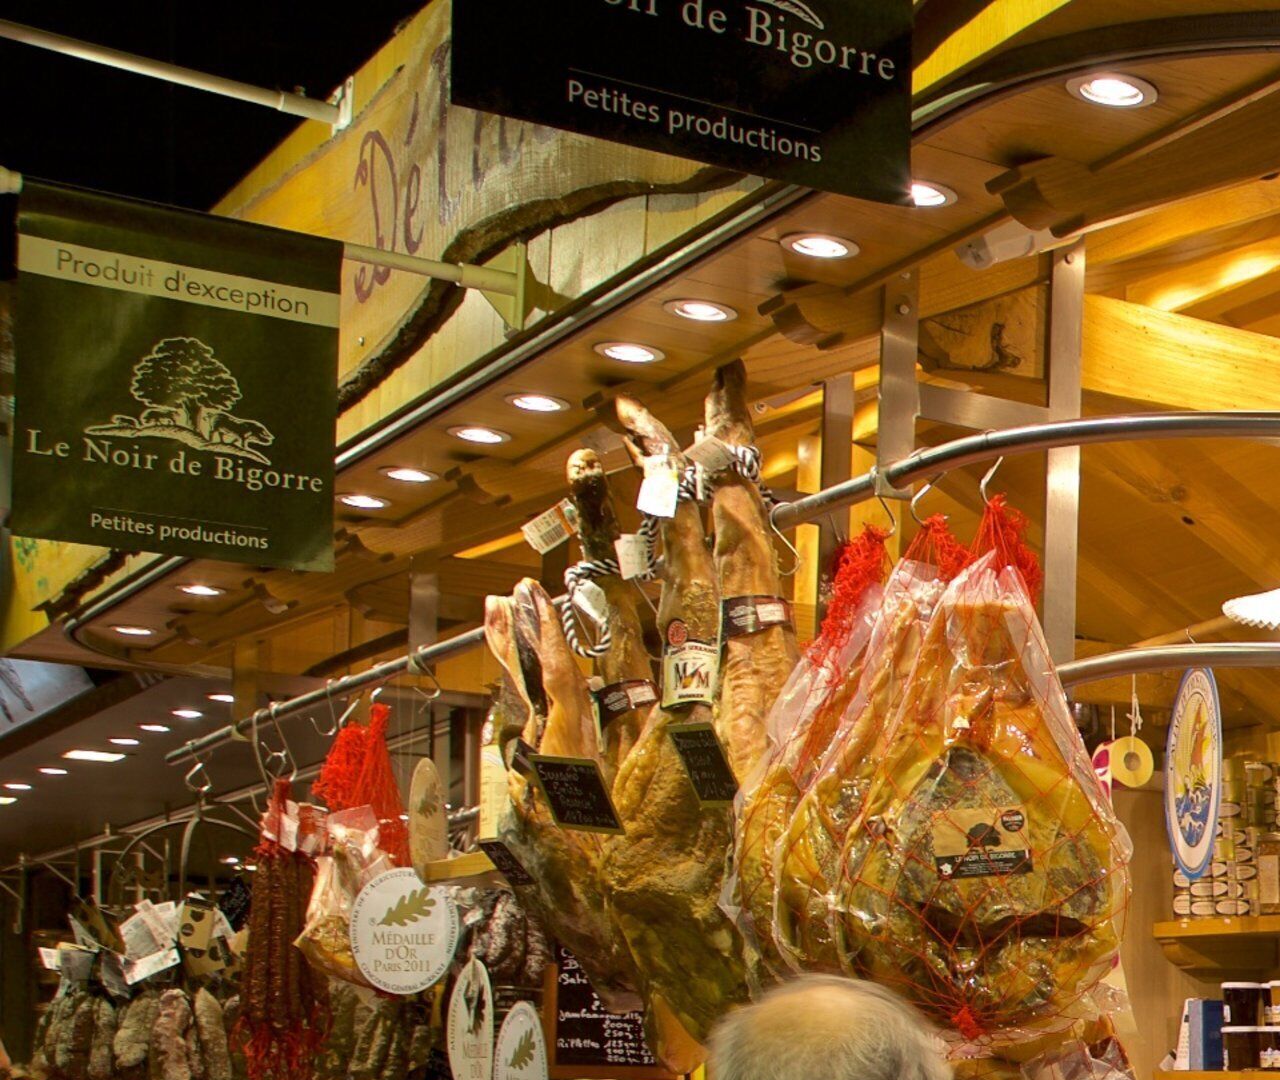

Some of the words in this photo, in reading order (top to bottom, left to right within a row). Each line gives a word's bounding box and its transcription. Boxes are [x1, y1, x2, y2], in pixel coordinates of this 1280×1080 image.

[745, 6, 896, 81] Bigorre
[568, 79, 660, 123] Petites
[668, 109, 822, 163] productions
[56, 248, 155, 288] Produit
[164, 275, 310, 318] d'exception
[27, 429, 70, 458] Le
[83, 438, 158, 471] Noir
[170, 450, 202, 476] de
[214, 456, 323, 492] Bigorre
[91, 513, 155, 536] Petites
[160, 526, 268, 549] productions
[403, 960, 431, 972] 2011
